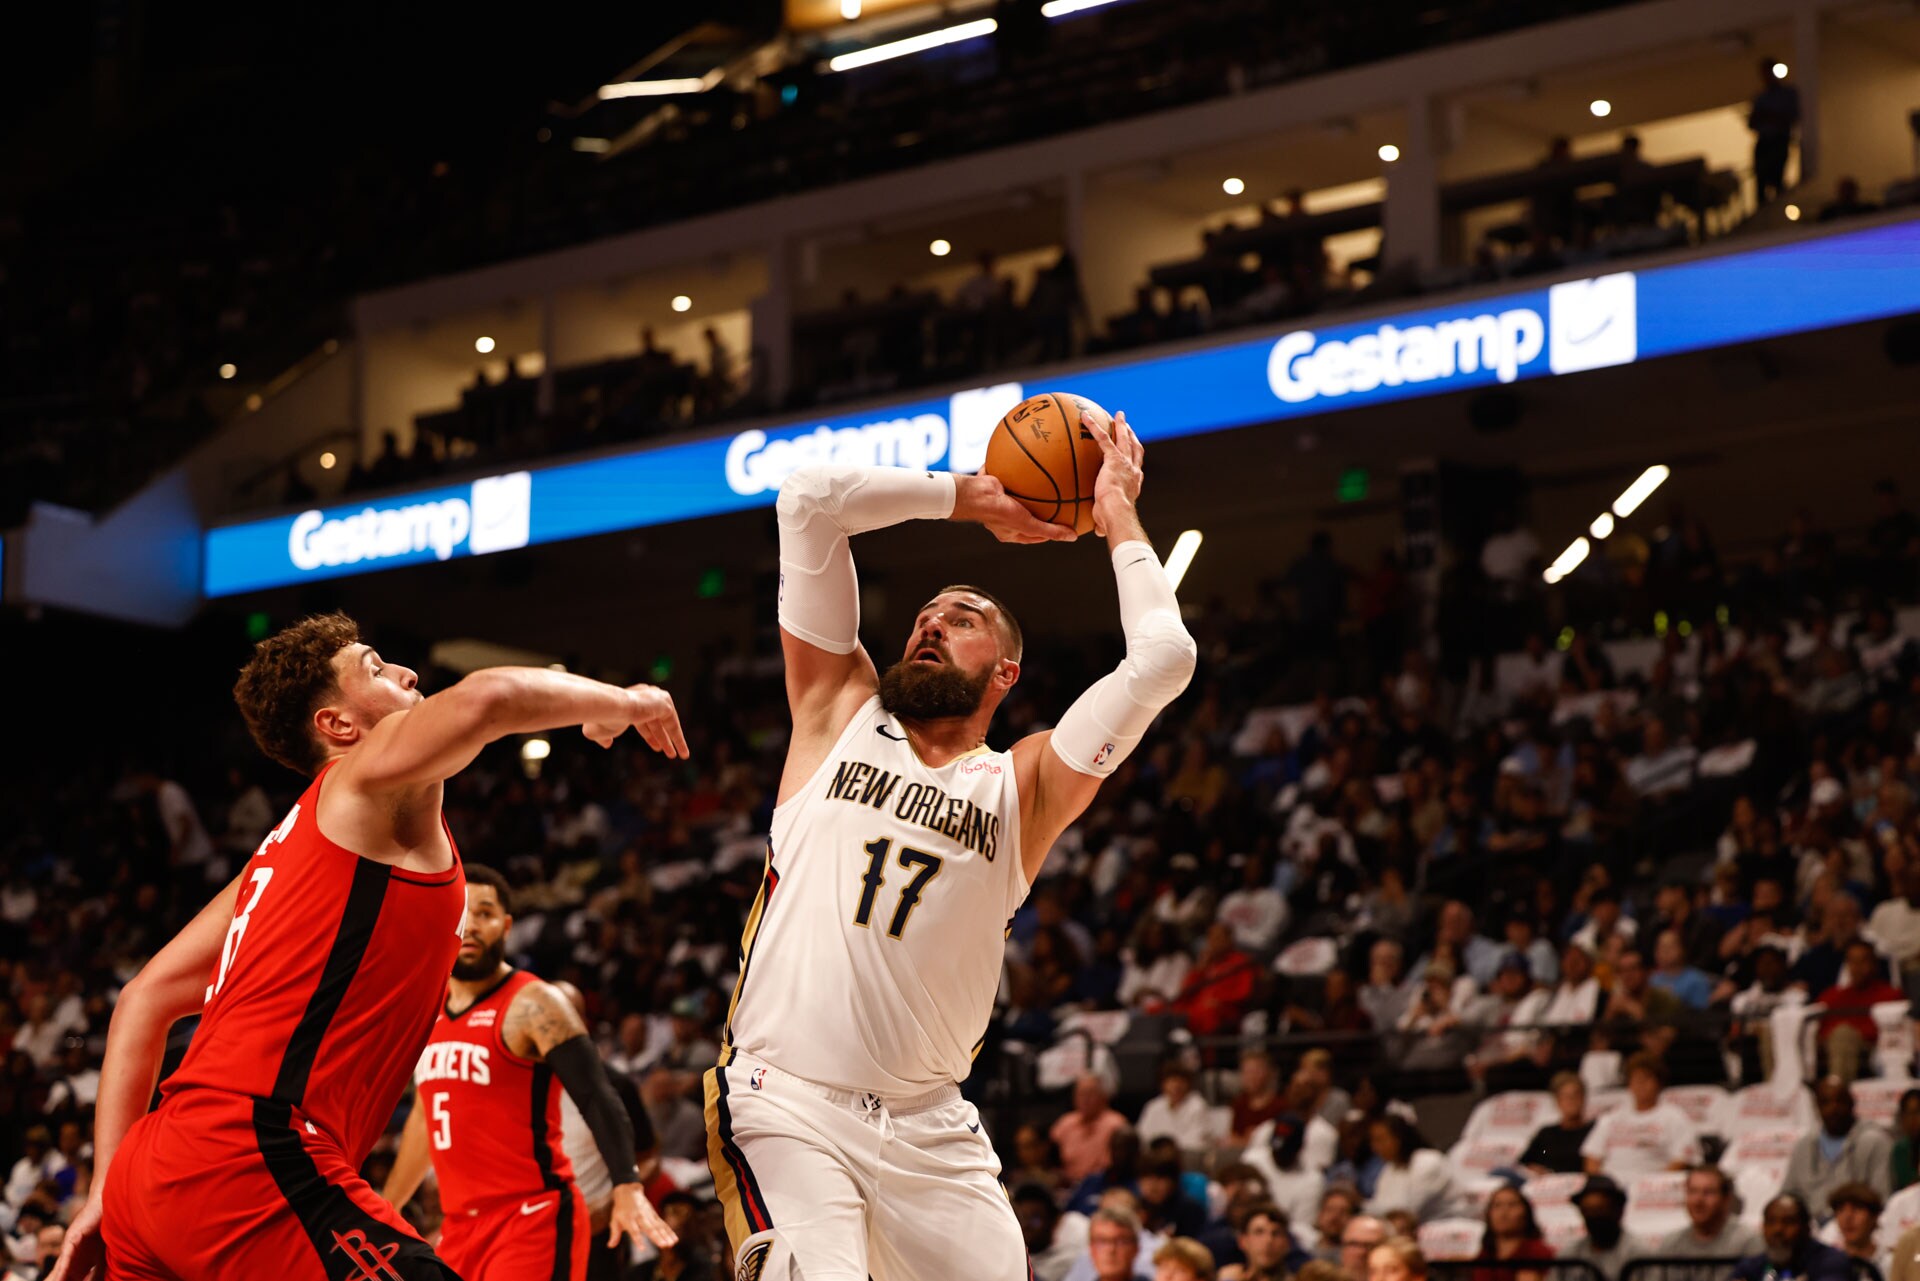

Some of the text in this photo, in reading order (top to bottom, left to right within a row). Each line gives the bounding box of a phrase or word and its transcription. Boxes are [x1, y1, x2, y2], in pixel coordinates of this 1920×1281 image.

[1267, 308, 1544, 403] Gestamp
[288, 498, 470, 570] Gestamp
[960, 761, 1002, 775] ibotta
[826, 761, 999, 863] NEW ORLEANS
[853, 835, 944, 941] 17
[432, 1091, 452, 1150] 5
